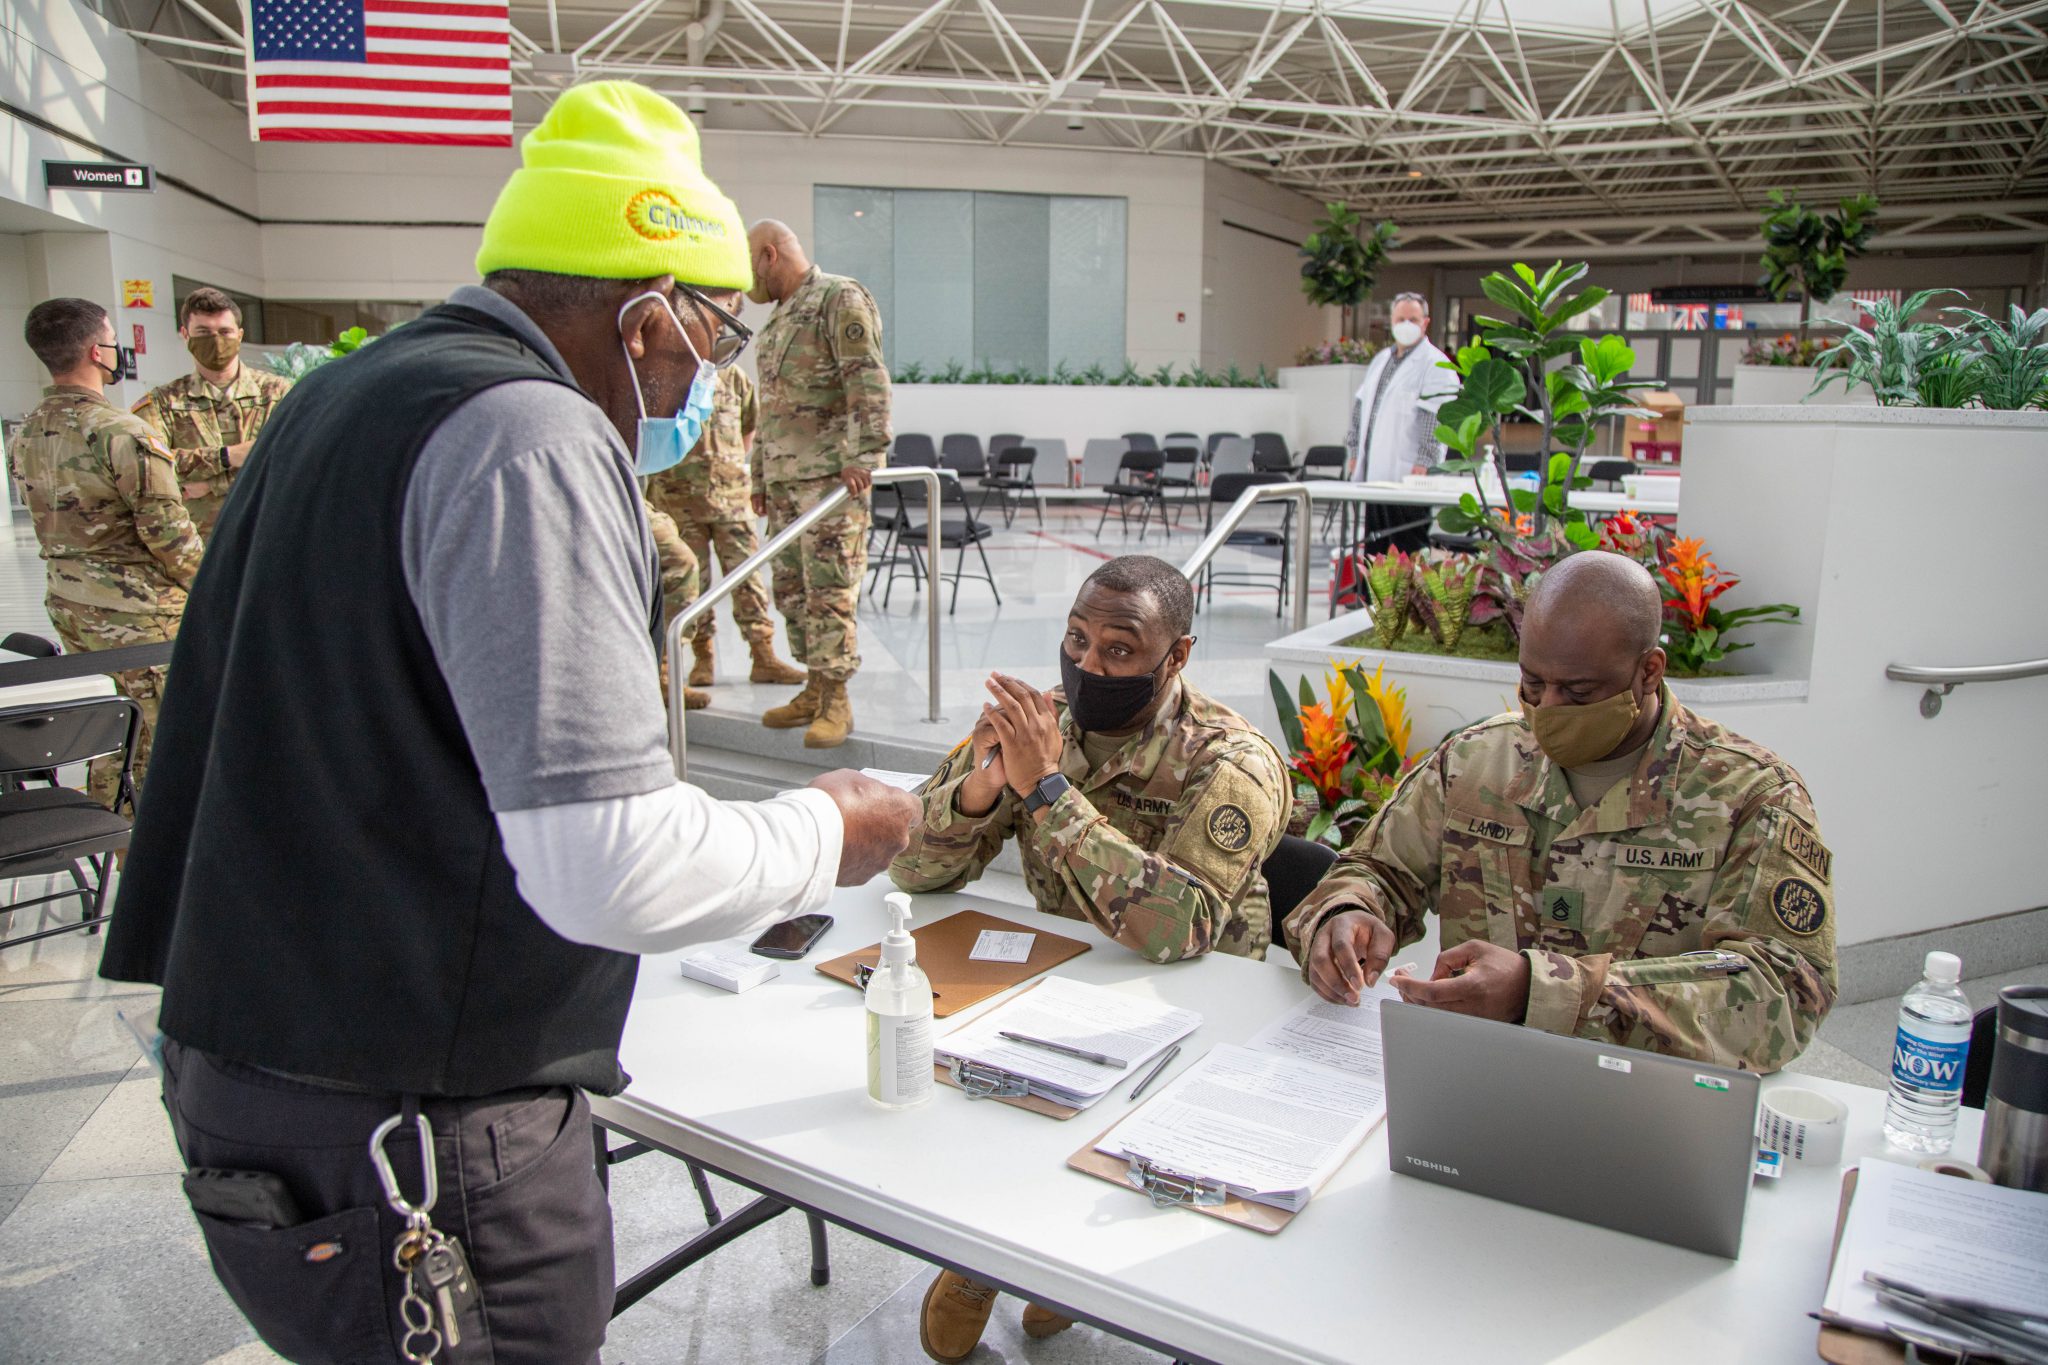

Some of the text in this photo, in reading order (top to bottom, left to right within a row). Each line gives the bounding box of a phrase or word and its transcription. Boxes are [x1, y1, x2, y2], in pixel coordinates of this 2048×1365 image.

[73, 168, 123, 183] Women
[1135, 797, 1171, 815] ARMY
[1467, 818, 1514, 841] LANDY
[1626, 848, 1705, 868] U.S. ARMY
[1789, 826, 1830, 877] CBRN
[1894, 1044, 1961, 1081] NOW
[1405, 1155, 1460, 1176] TOSHIBA
